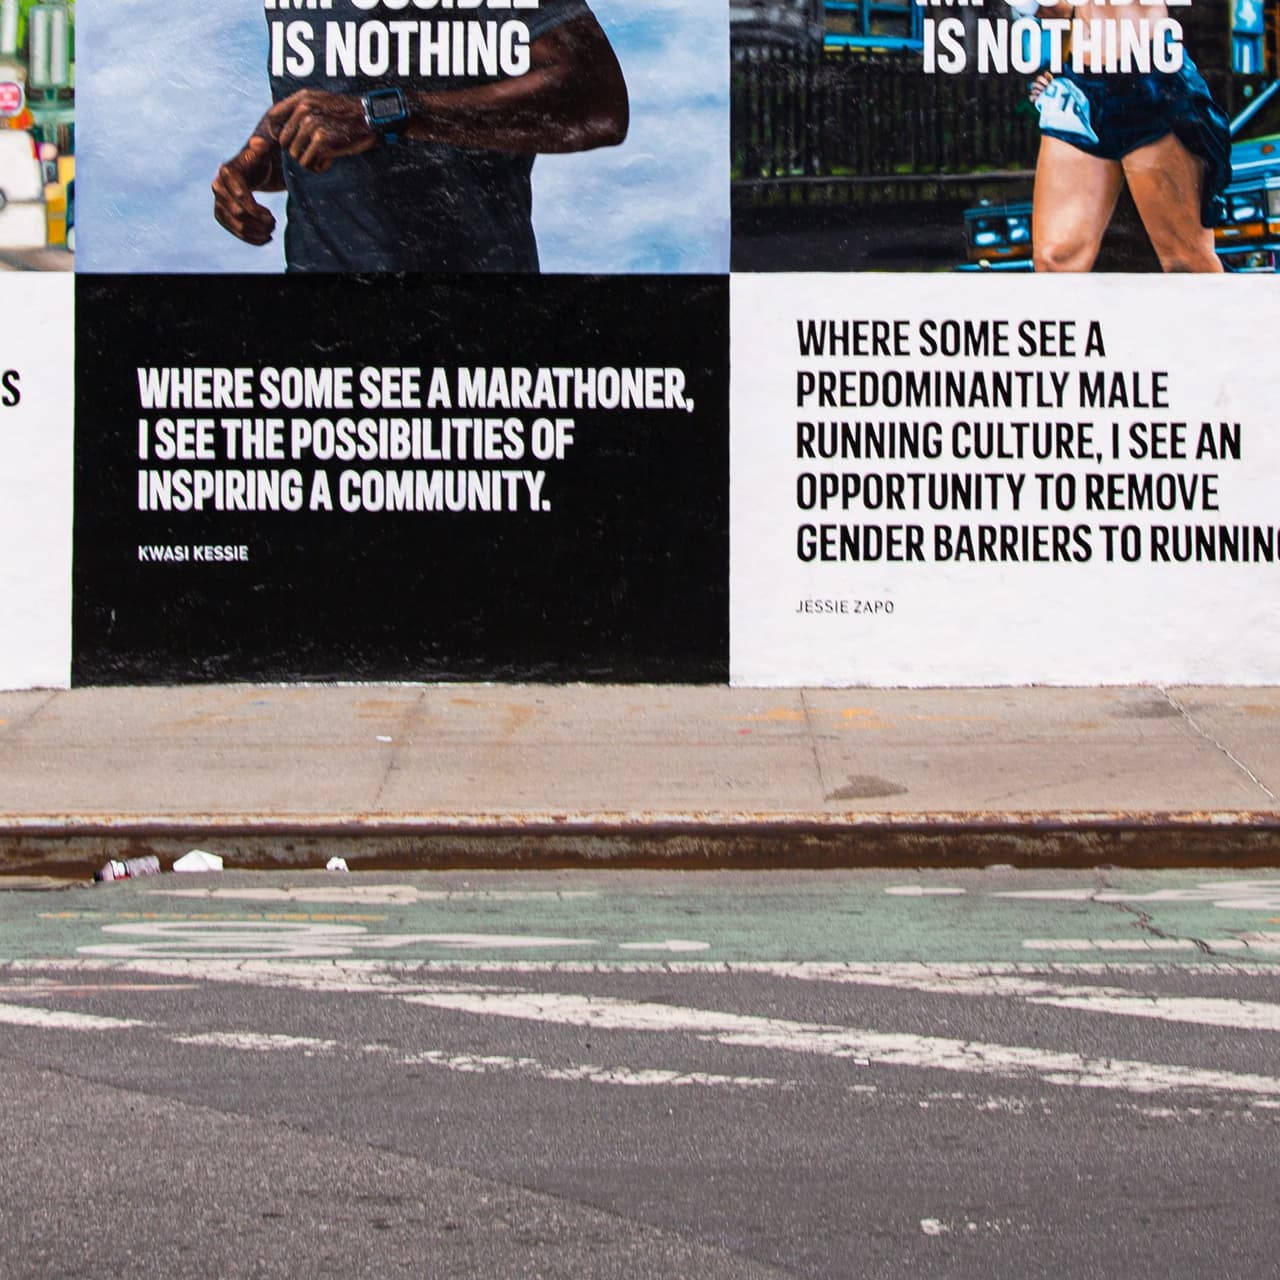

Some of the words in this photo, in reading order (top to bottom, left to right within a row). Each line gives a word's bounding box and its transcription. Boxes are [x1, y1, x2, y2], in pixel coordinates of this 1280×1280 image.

[272, 21, 314, 77] IS
[326, 21, 530, 77] NOTHING
[923, 18, 966, 74] IS
[978, 18, 1183, 74] NOTHING
[797, 320, 910, 357] WHERE
[919, 320, 1010, 357] SOME
[1018, 320, 1076, 357] SEE
[1084, 320, 1106, 357] A
[137, 367, 253, 409] WHERE
[259, 367, 354, 409] SOME
[359, 367, 421, 409] SEE
[427, 367, 452, 409] A
[457, 367, 695, 413] MARATHONER,
[797, 371, 1069, 408] PREDOMINANTLY
[1079, 371, 1169, 408] MALE
[138, 418, 149, 460] I
[154, 418, 215, 460] SEE
[221, 419, 285, 460] THE
[291, 418, 525, 461] POSSIBILITIES
[532, 418, 575, 460] OF
[797, 422, 942, 459] RUNNING
[952, 422, 1102, 464] CULTURE,
[1112, 423, 1120, 460] I
[1129, 423, 1187, 460] SEE
[1196, 423, 1241, 460] AN
[138, 469, 303, 511] INSPIRING
[309, 469, 333, 511] A
[339, 469, 551, 513] COMMUNITY.
[797, 473, 1026, 511] OPPORTUNITY
[1035, 474, 1076, 511] TO
[1085, 474, 1219, 511] REMOVE
[138, 545, 190, 562] KWASI
[194, 545, 249, 562] KESSIE
[797, 524, 926, 563] GENDER
[934, 524, 1092, 563] BARRIERS
[1100, 525, 1142, 563] TO
[795, 600, 849, 615] JESSIE
[853, 600, 895, 615] ZAPO
